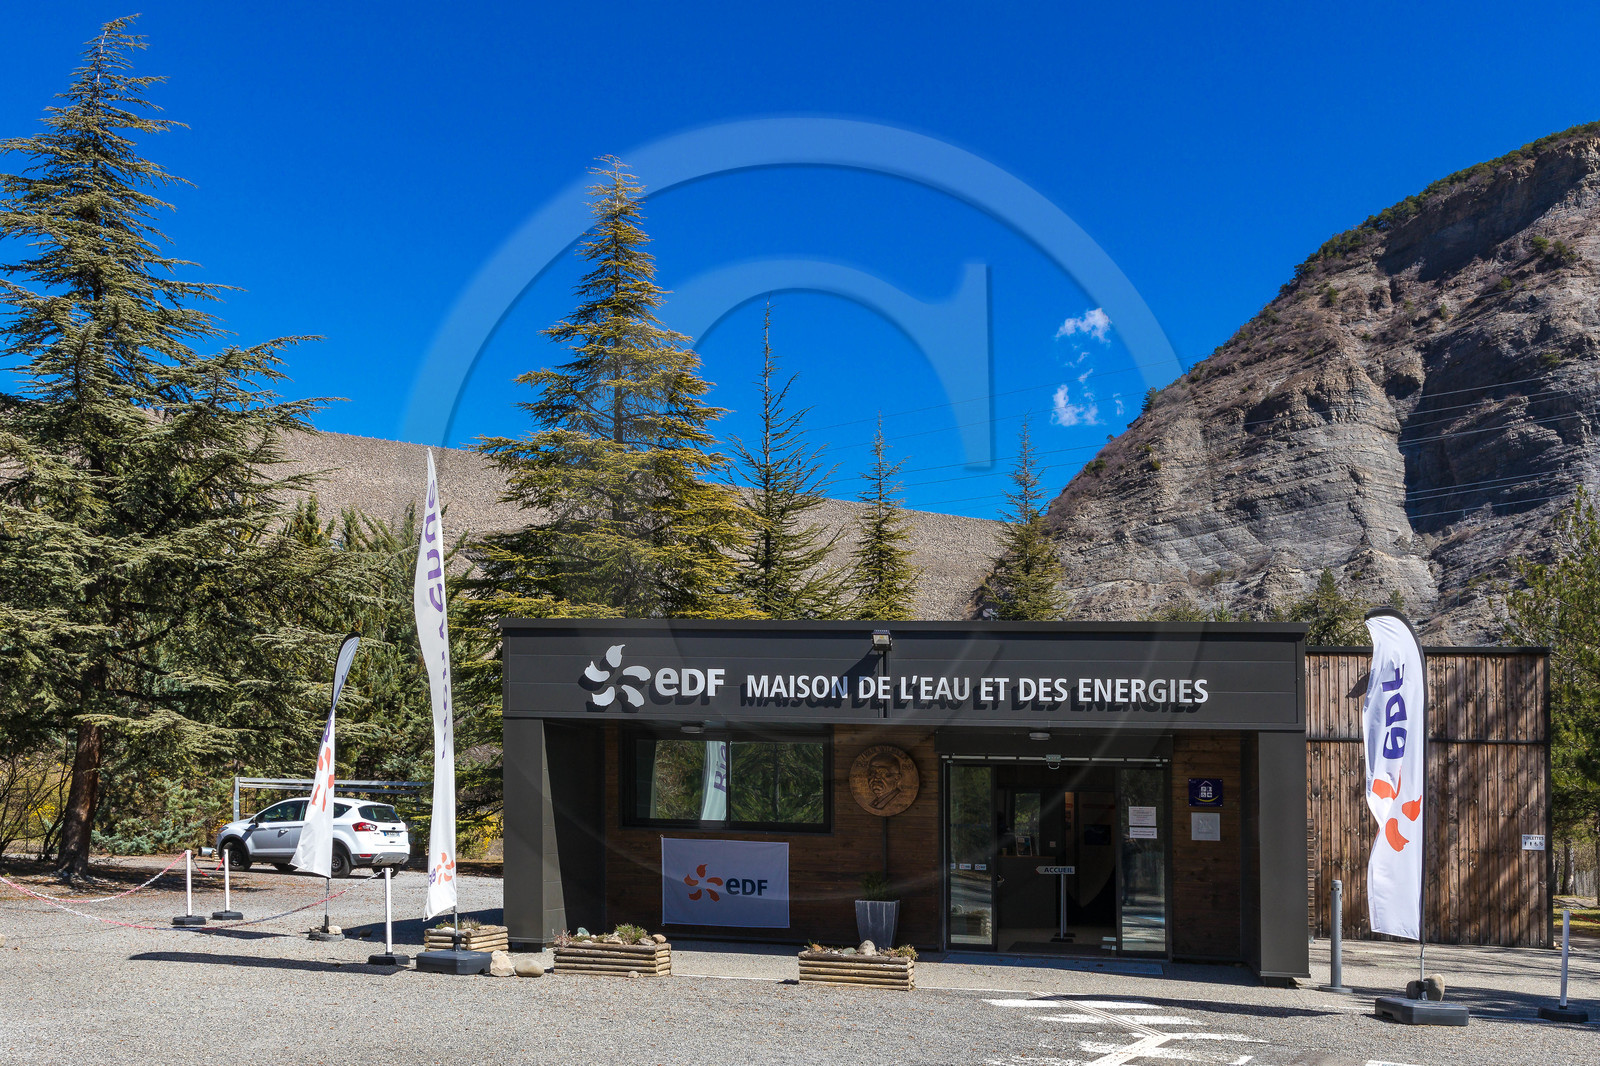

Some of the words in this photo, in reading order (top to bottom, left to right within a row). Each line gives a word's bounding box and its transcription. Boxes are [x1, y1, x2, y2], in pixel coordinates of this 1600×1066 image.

[747, 674, 848, 699] MAISON
[858, 675, 891, 700] DE
[900, 675, 970, 701] L'EAU
[980, 677, 1009, 701] ET
[1018, 678, 1068, 702] DES
[1078, 678, 1210, 704] ENERGIES
[1043, 866, 1074, 874] ACCUEIL
